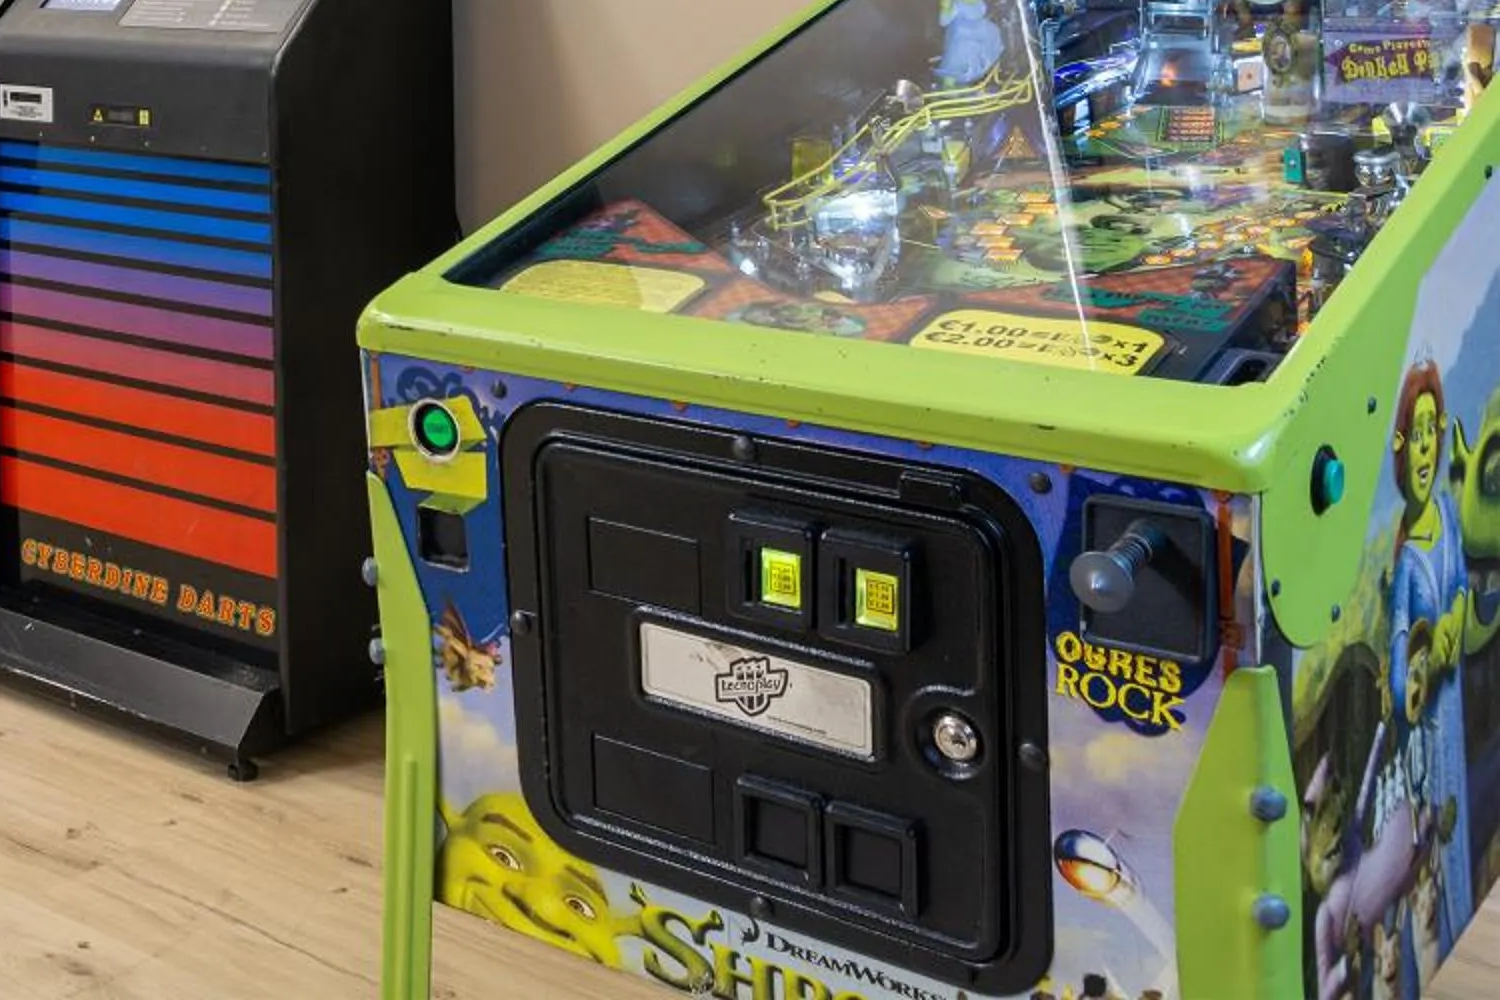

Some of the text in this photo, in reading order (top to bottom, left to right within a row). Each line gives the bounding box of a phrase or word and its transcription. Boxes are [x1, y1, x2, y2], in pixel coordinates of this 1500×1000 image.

[21, 538, 277, 637] CYBERDINE DARTS
[1055, 631, 1182, 694] OGRES
[1055, 662, 1186, 731] ROCK
